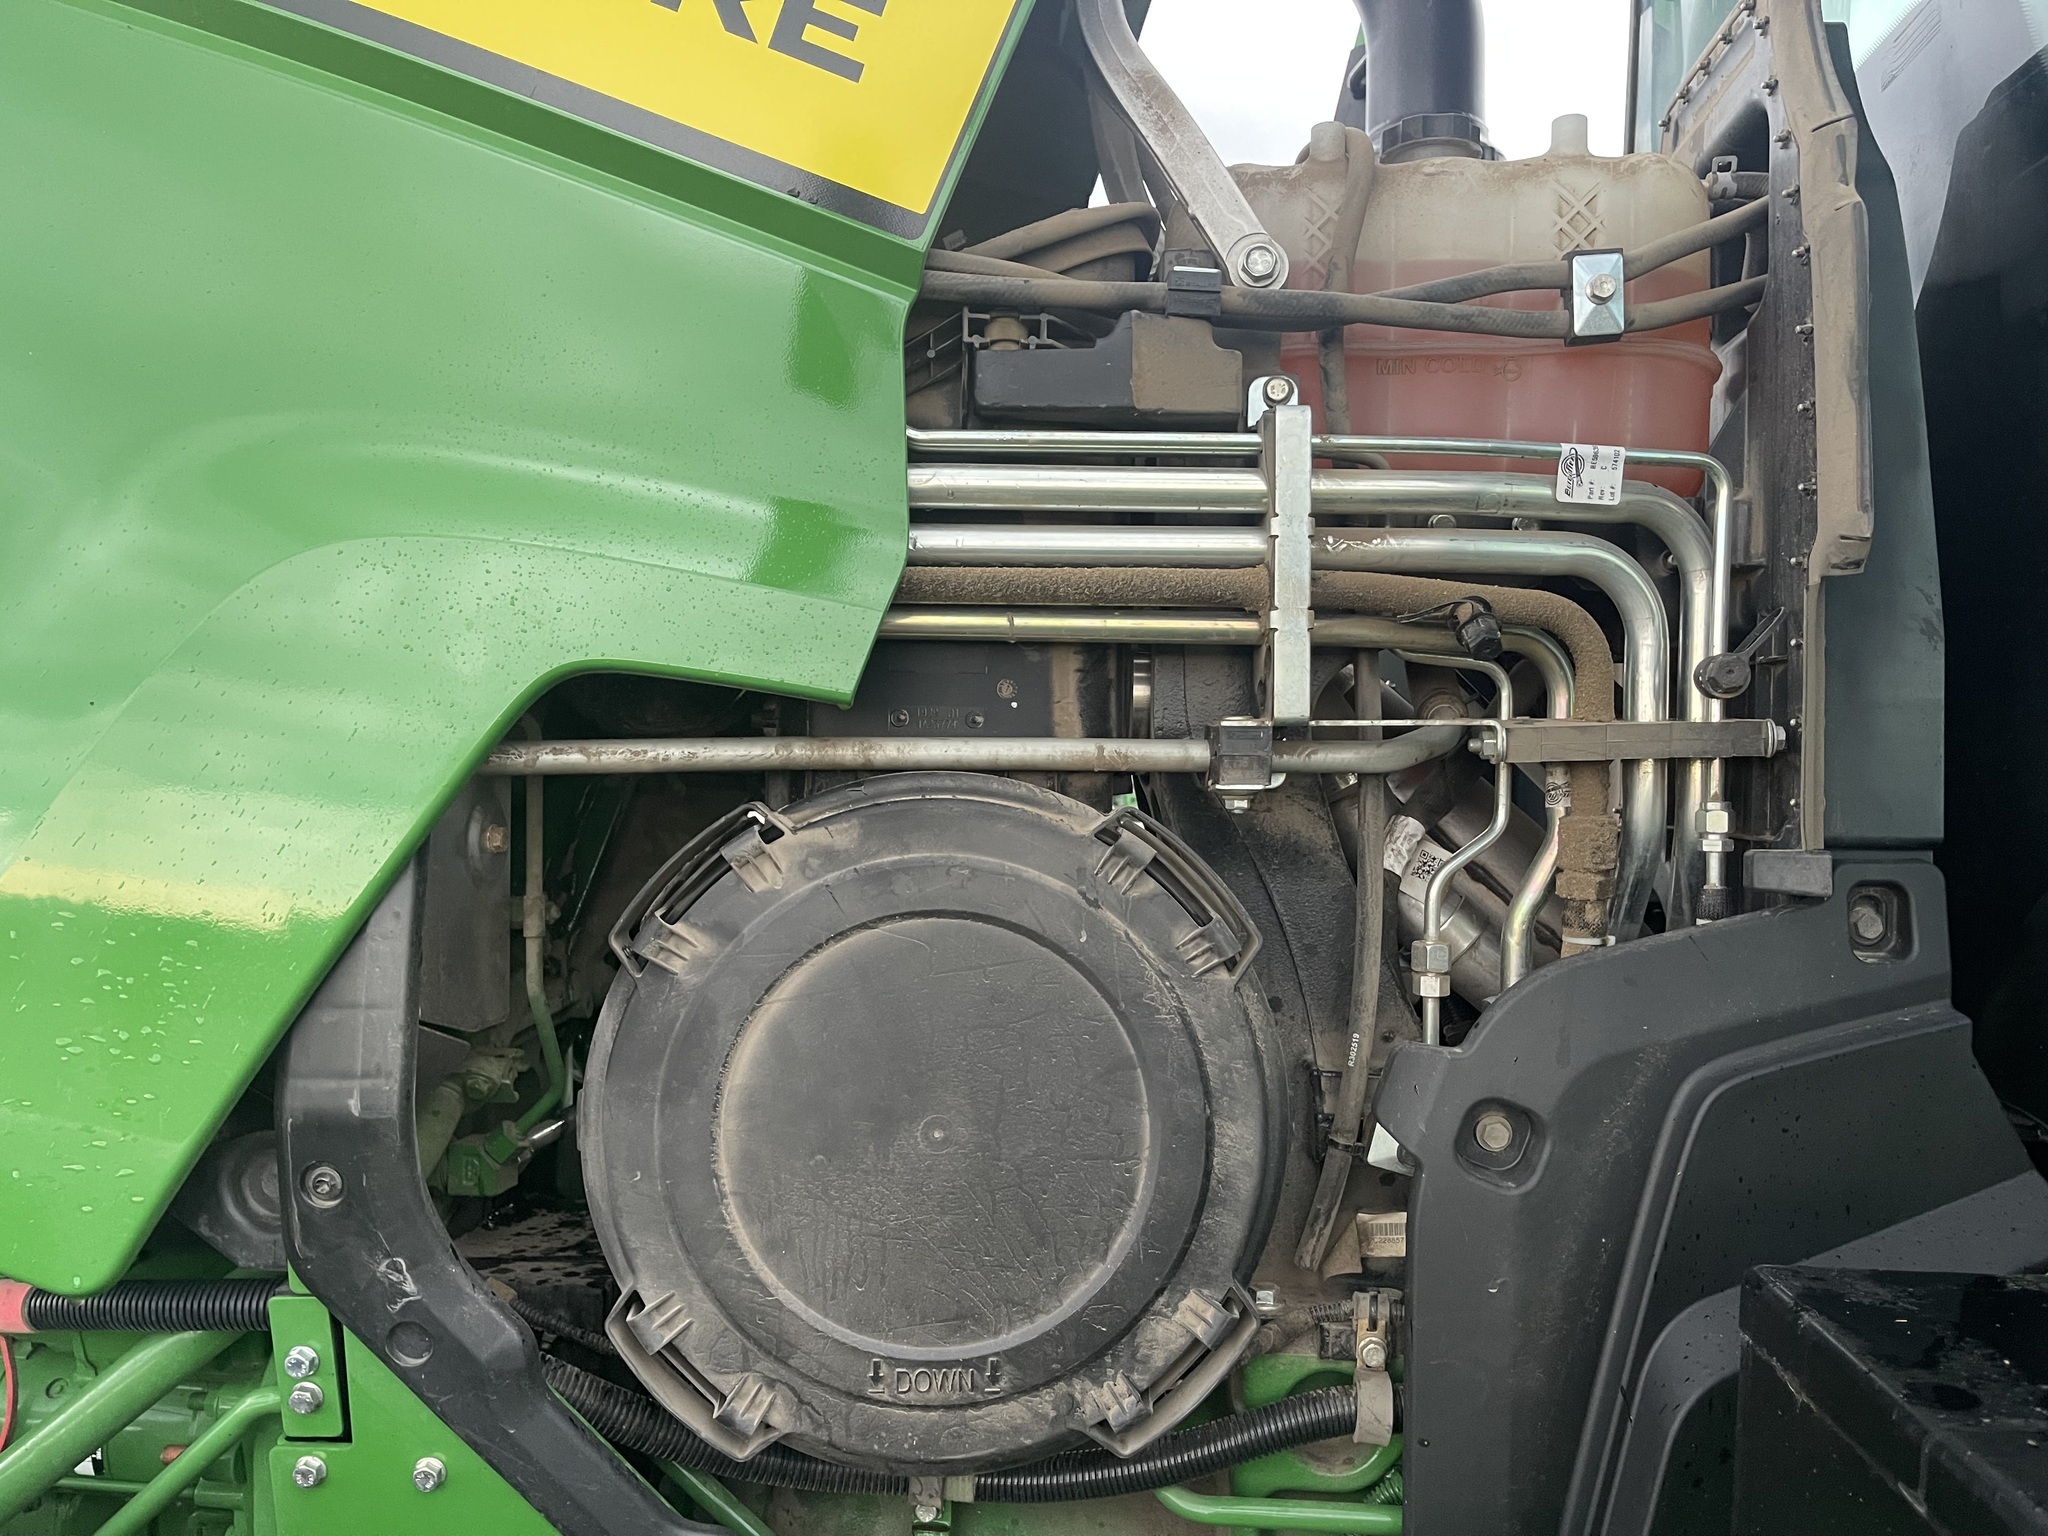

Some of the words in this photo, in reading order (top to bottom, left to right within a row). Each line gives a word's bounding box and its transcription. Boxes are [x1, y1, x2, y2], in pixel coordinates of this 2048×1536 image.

[1376, 358, 1416, 375] MIN
[1425, 357, 1485, 373] COLD
[1347, 1032, 1361, 1067] R302519
[895, 1367, 976, 1395] DOWN
